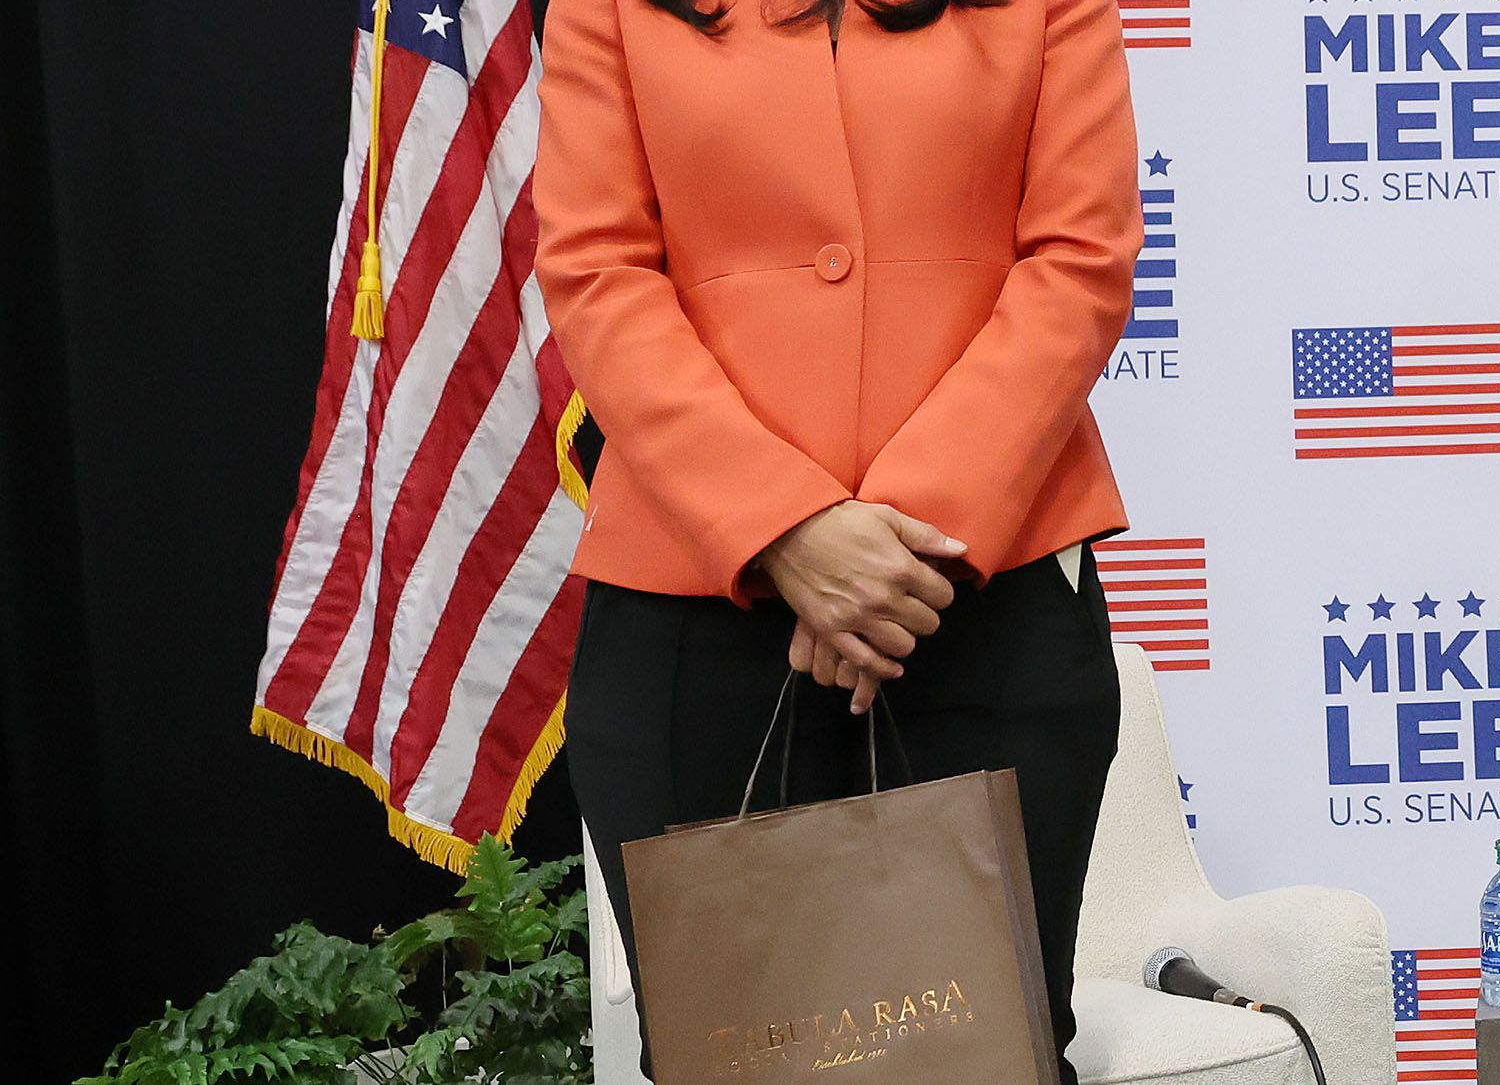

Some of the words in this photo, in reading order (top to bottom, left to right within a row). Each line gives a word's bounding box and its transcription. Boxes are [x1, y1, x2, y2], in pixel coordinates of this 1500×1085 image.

[1307, 173, 1369, 203] U.S.
[1329, 795, 1392, 826] U.S.
[707, 1008, 860, 1048] TBULA
[873, 979, 971, 1027] RASA
